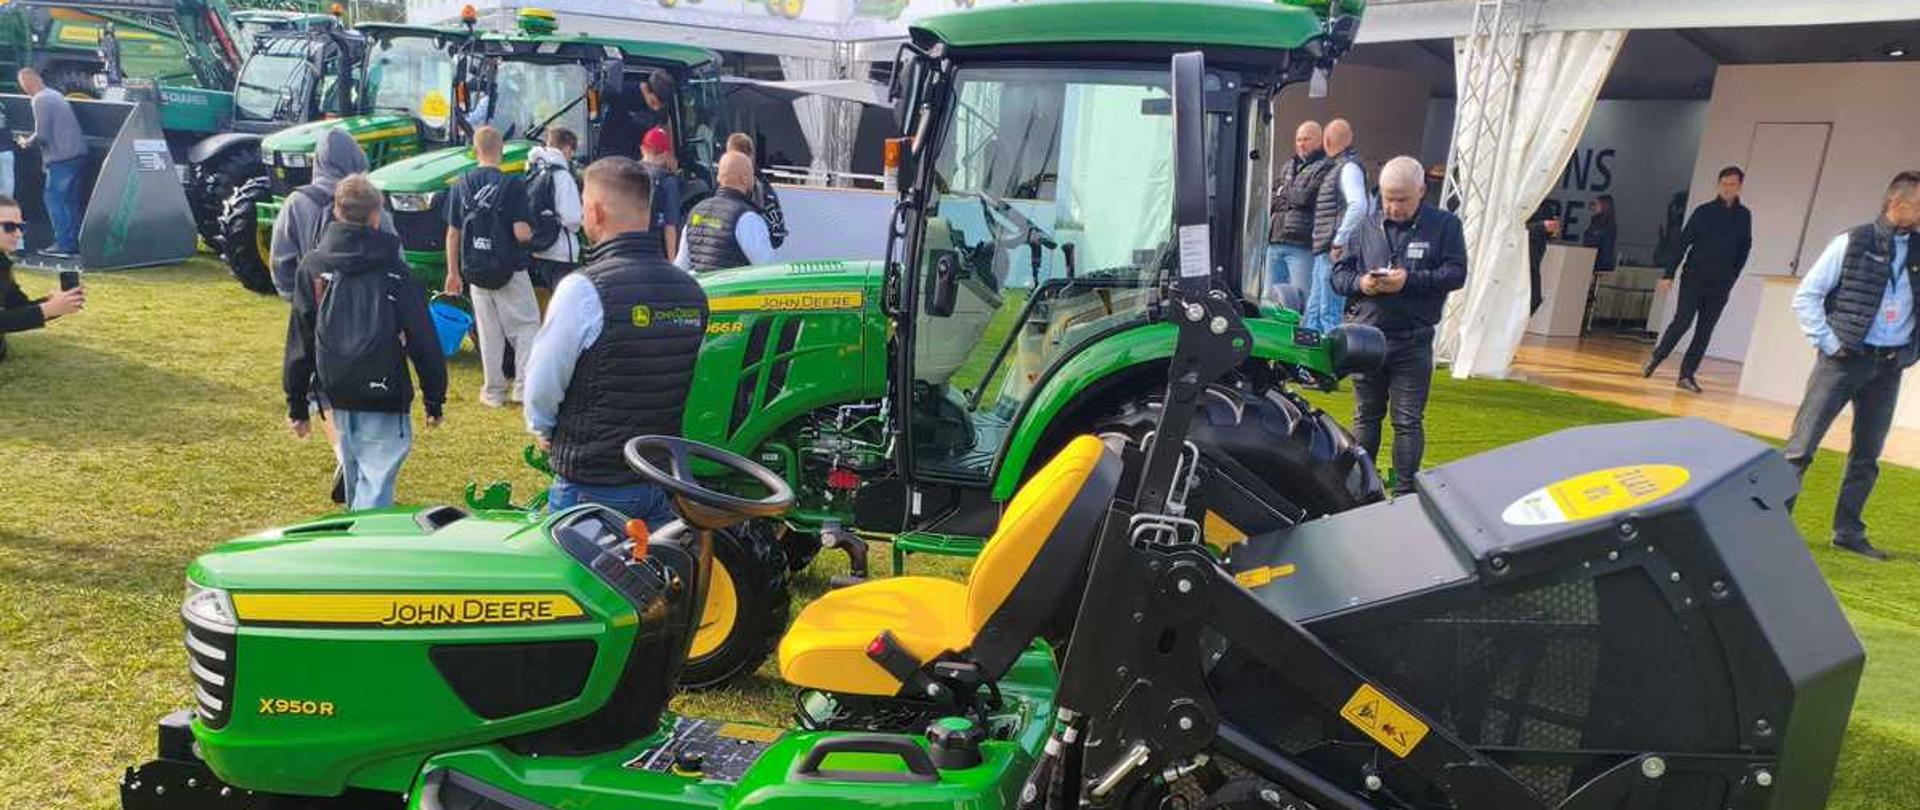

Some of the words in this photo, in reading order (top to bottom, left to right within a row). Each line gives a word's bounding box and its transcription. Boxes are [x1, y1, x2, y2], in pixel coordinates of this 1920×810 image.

[1563, 149, 1616, 192] NS
[762, 297, 799, 309] JOHN
[801, 295, 850, 307] DEERE
[382, 601, 455, 622] JOHN
[463, 600, 553, 620] DEERE
